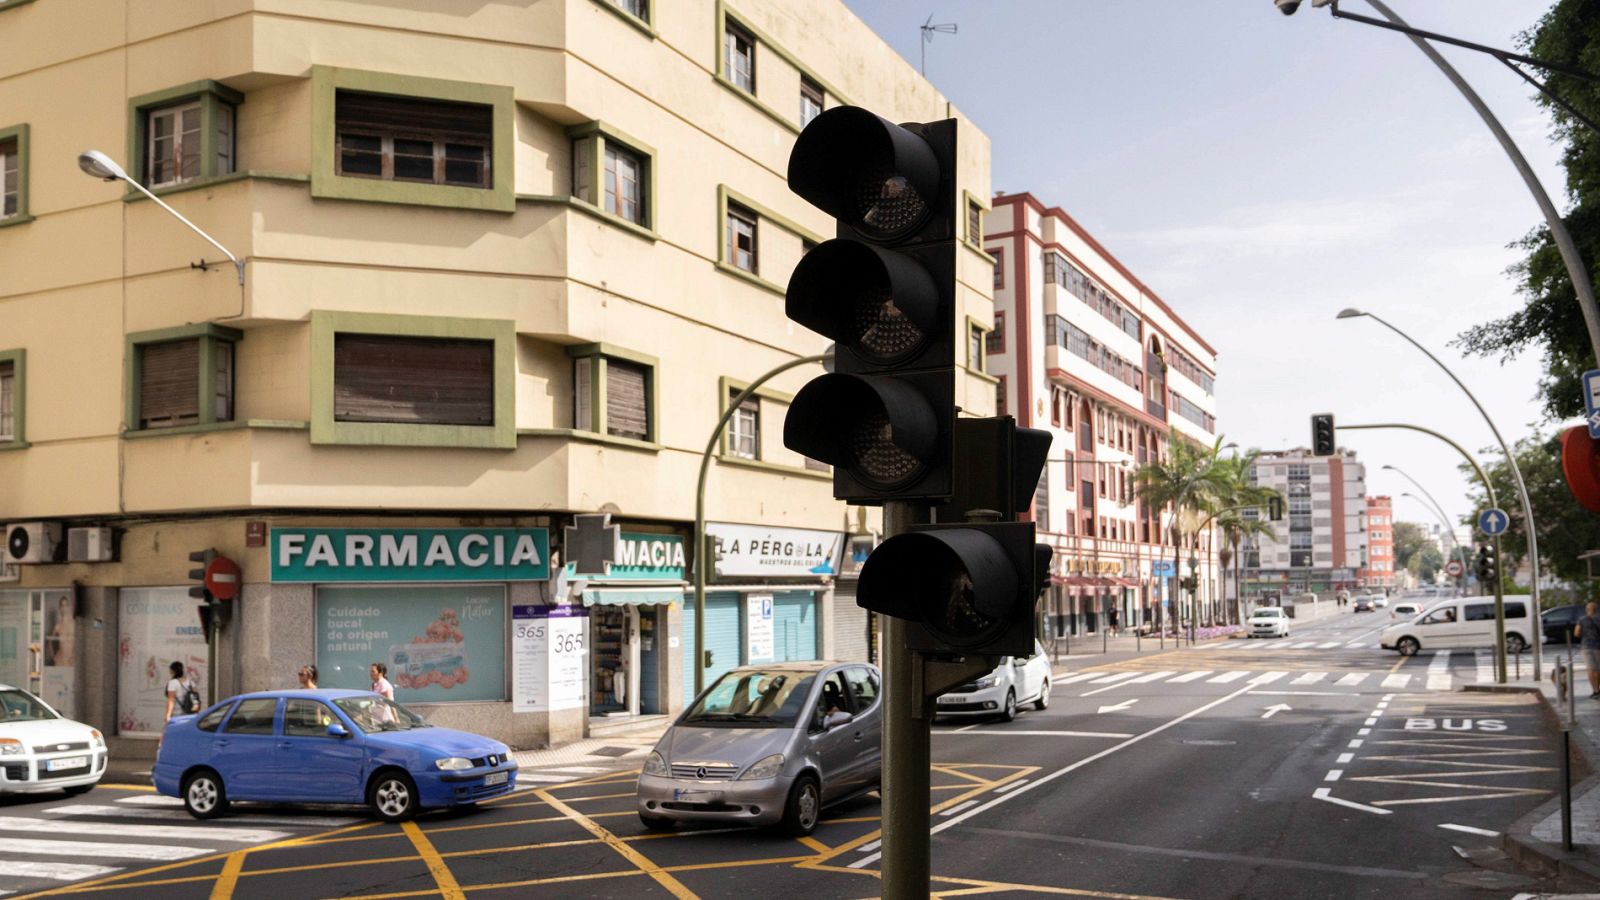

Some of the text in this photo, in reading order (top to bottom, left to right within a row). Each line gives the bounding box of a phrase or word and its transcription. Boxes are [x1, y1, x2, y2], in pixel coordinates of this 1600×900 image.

[279, 534, 540, 567] FARMACIA
[616, 539, 686, 567] MACIA
[720, 540, 740, 554] LA
[327, 607, 381, 617] Cuidado
[327, 618, 362, 628] bucal
[327, 630, 388, 641] de origen
[517, 626, 545, 639] 365
[327, 641, 372, 652] natural
[554, 633, 584, 654] 365
[1404, 718, 1508, 731] BUS
